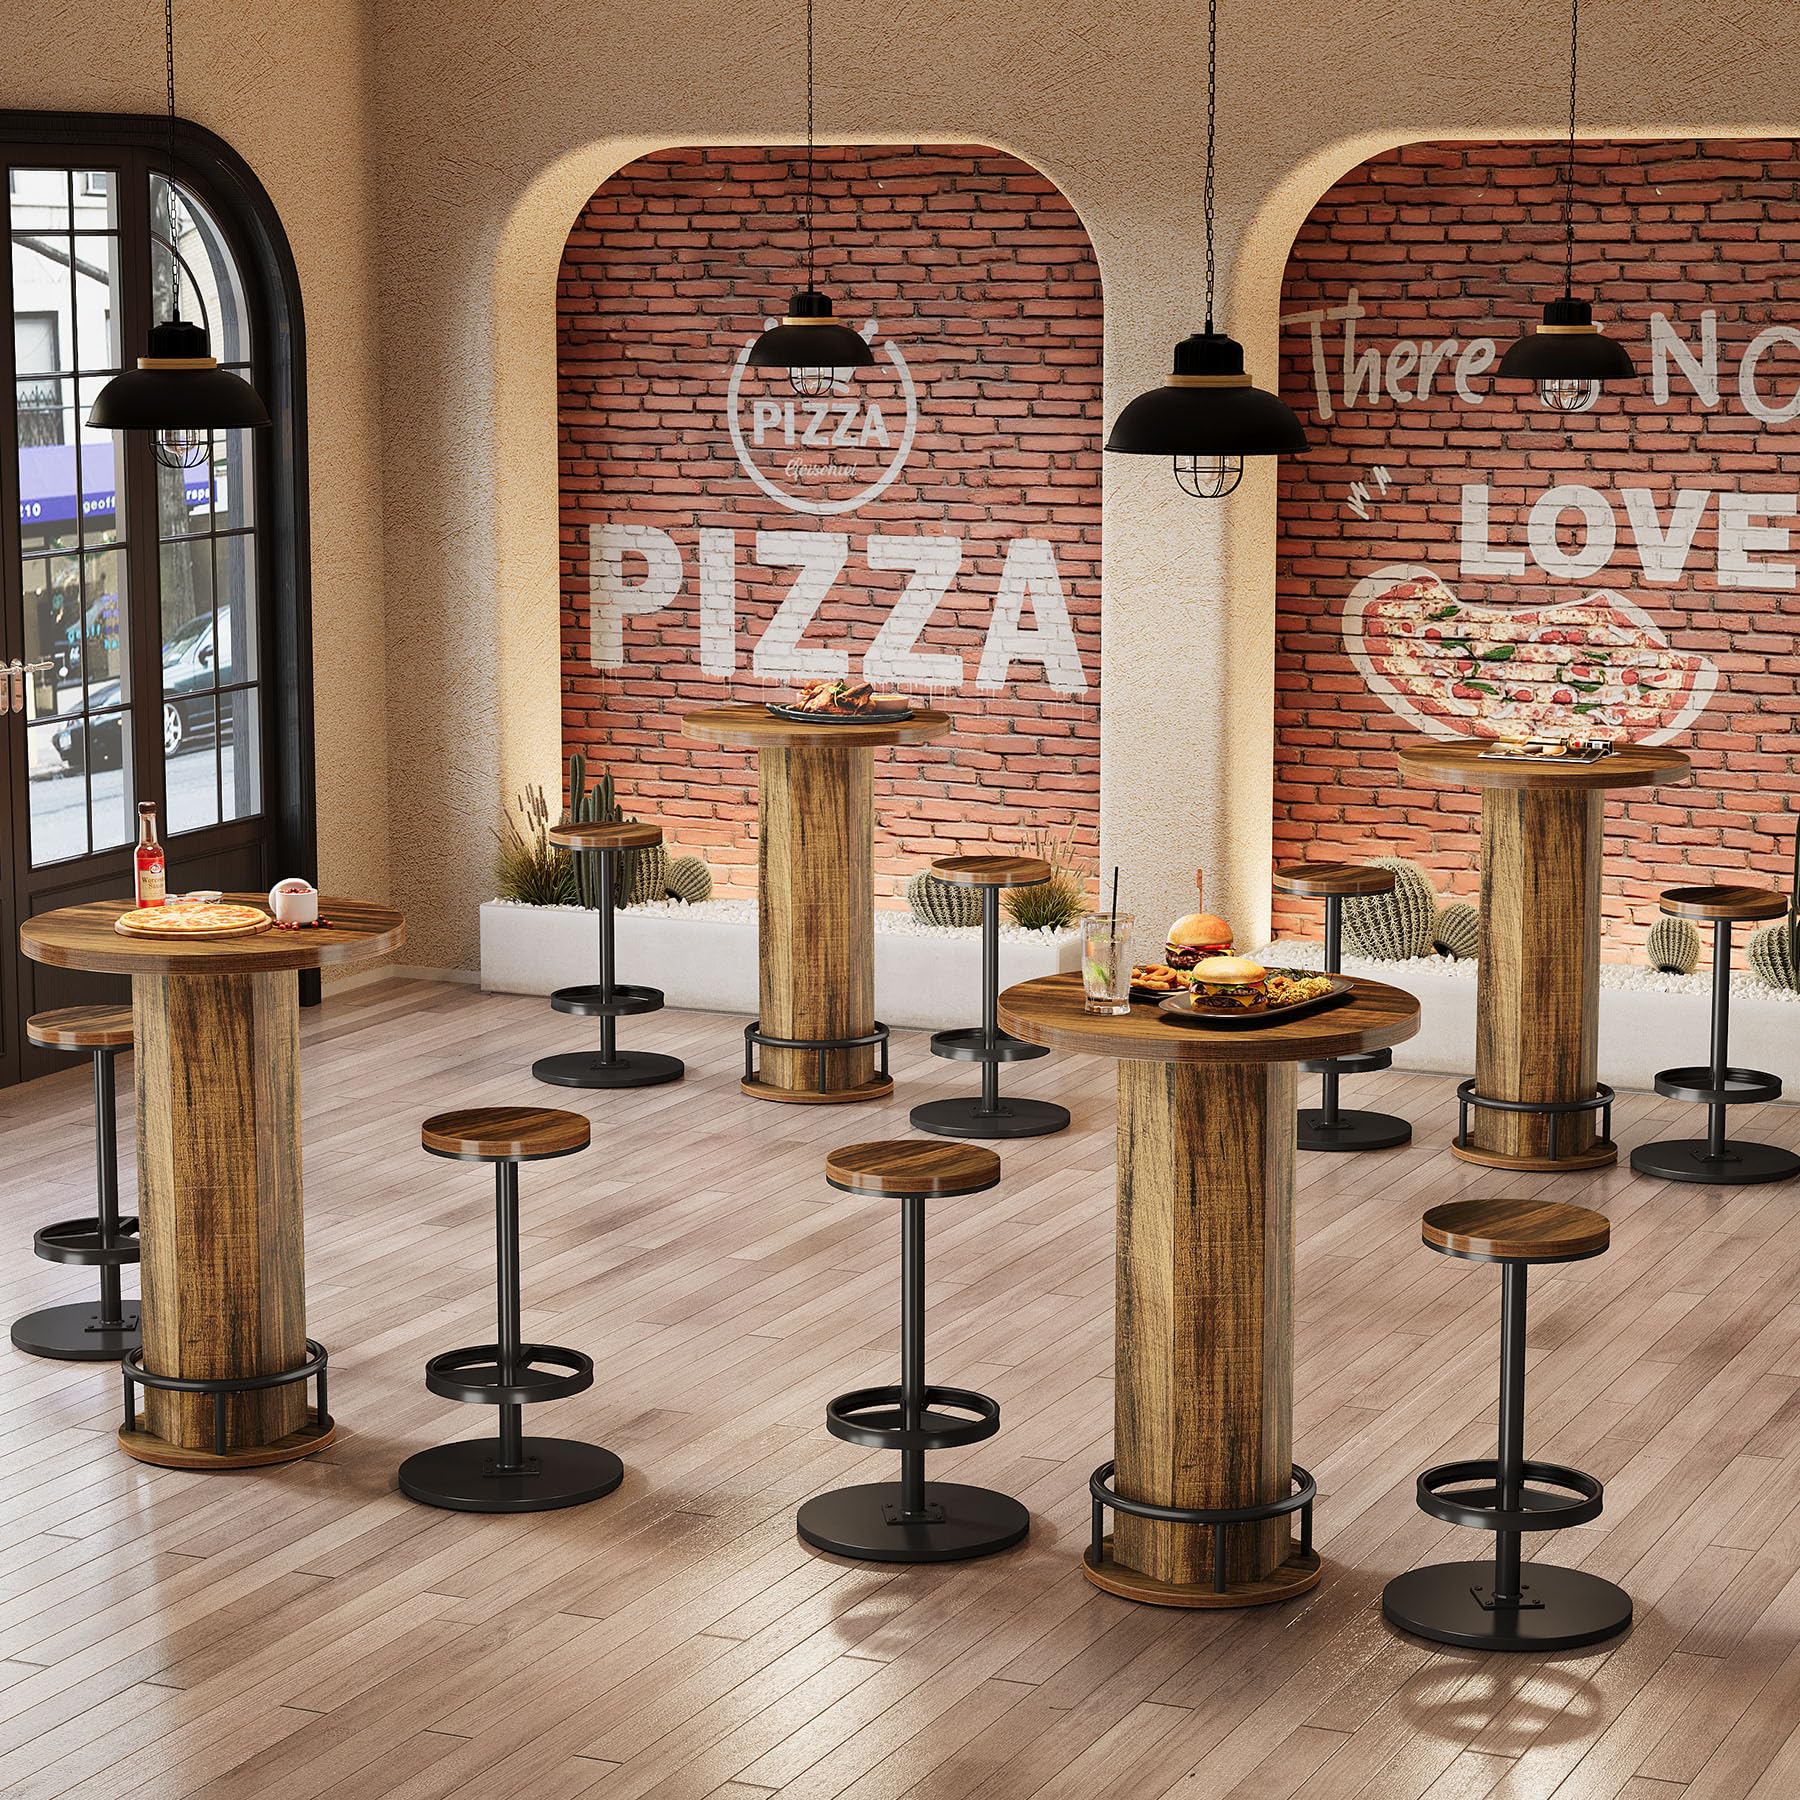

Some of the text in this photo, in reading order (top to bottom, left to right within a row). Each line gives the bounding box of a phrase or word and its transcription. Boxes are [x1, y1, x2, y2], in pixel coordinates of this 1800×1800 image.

[1279, 287, 1496, 420] There
[753, 401, 891, 448] PIZZA
[1460, 483, 1798, 588] LOVE
[588, 523, 1089, 694] PIZZA
